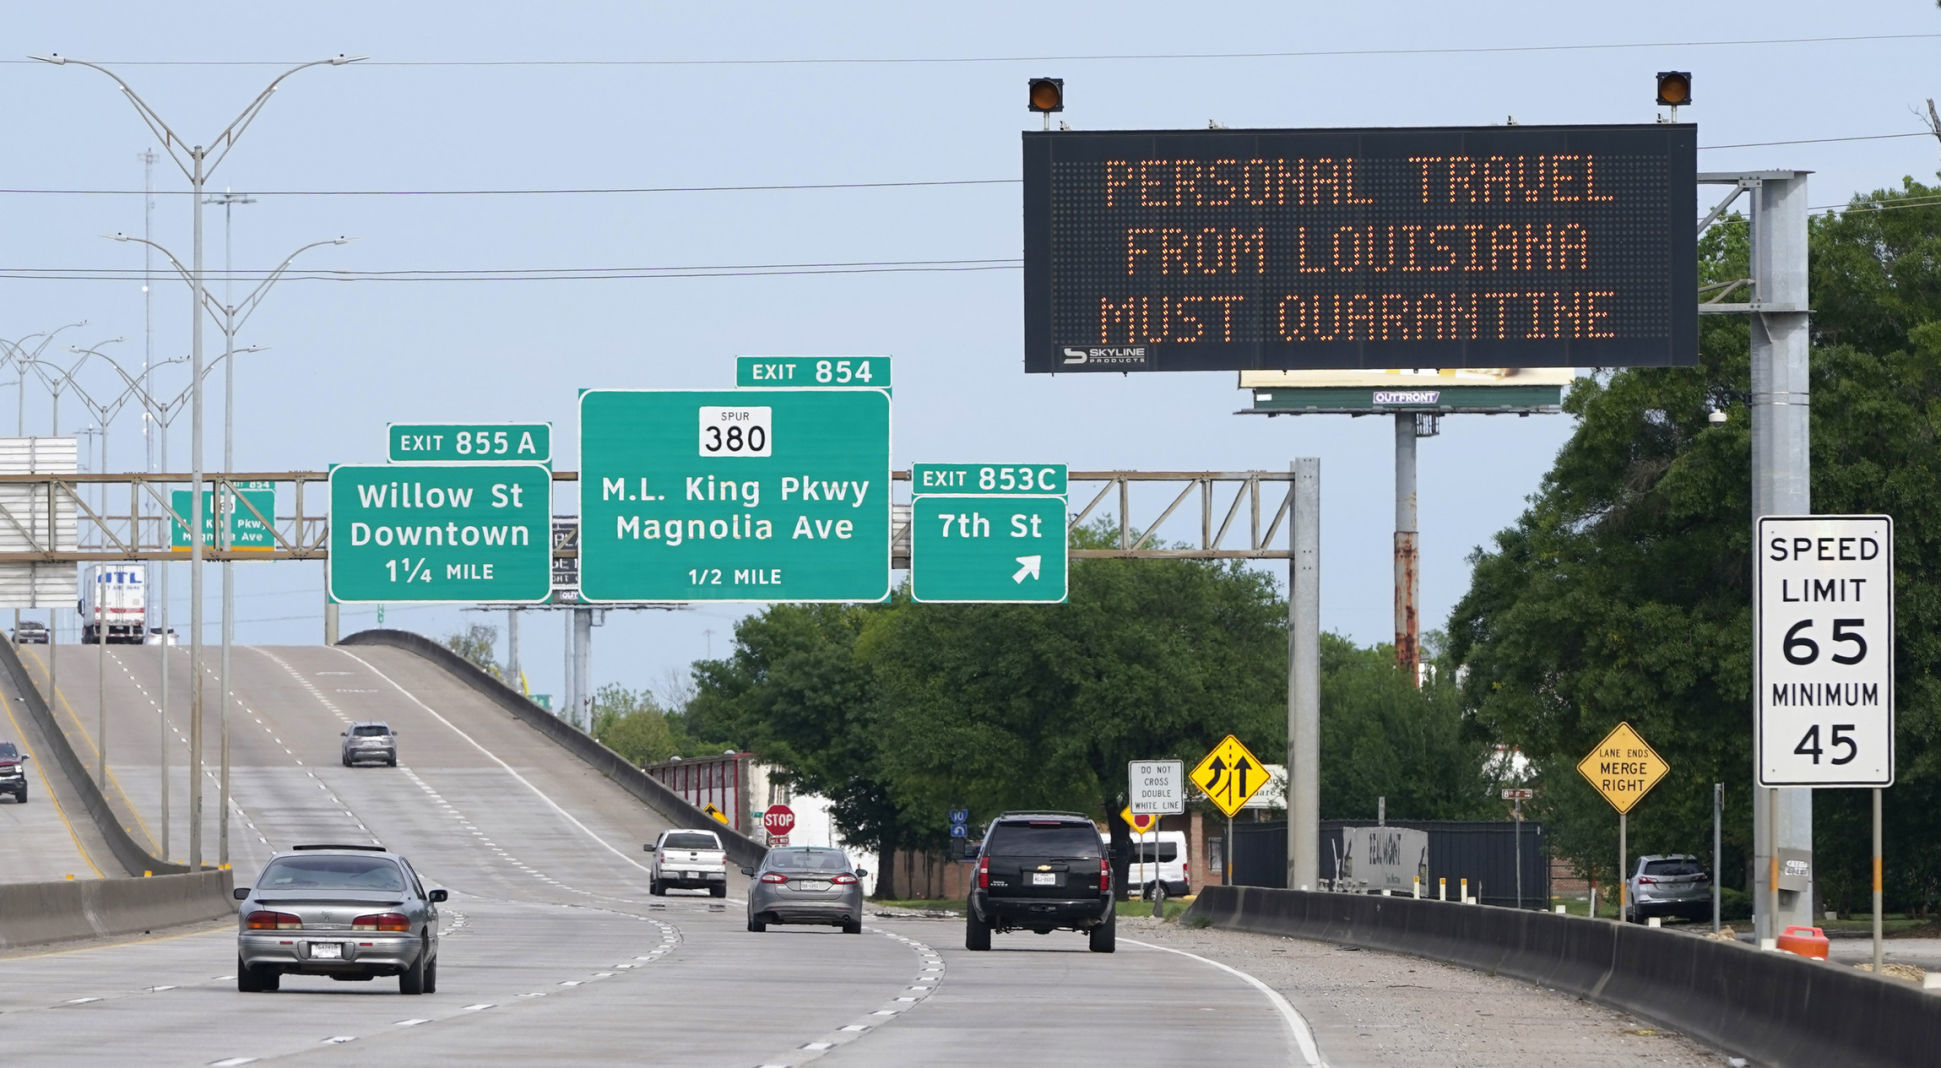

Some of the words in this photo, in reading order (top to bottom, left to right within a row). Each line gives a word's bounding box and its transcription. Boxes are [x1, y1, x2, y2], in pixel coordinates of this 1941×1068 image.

[1108, 159, 1372, 206] PERSONAL
[1409, 156, 1612, 202] TRAVEL
[1129, 228, 1264, 274] FROM
[1300, 224, 1586, 272] LOUISIANA
[1102, 296, 1243, 343] MUST
[1280, 292, 1614, 340] QUARANTINE
[1090, 348, 1144, 356] SKYLINE
[753, 364, 796, 379] EXIT
[816, 360, 872, 383] 854
[1376, 393, 1434, 402] OUTFRONT
[722, 412, 749, 421] SPUR
[402, 435, 443, 450] EXIT
[456, 432, 508, 454] 855
[518, 432, 536, 453] A
[706, 426, 765, 451] 380
[924, 471, 966, 486] EXIT
[979, 467, 1055, 490] 853C
[358, 482, 473, 508] Willow
[492, 484, 522, 507] St
[603, 478, 664, 500] M.L.
[687, 475, 759, 507] King
[782, 476, 869, 507] Pkwy
[352, 522, 528, 546] Downtown
[617, 515, 772, 546] Magnolia
[792, 516, 853, 539] Ave
[939, 512, 989, 537] 7th
[1011, 514, 1041, 537] St
[241, 533, 263, 541] Ave
[1771, 538, 1878, 561] SPEED
[447, 564, 493, 579] MILE
[689, 569, 721, 584] 1/2
[735, 569, 781, 584] MILE
[1783, 579, 1866, 602] LIMIT
[1783, 619, 1867, 665] 65
[1773, 683, 1877, 706] MINIMUM
[1600, 749, 1620, 757] LANE
[1794, 725, 1857, 765] 45
[1601, 762, 1647, 774] MERGE
[1603, 780, 1644, 791] RIGHT
[954, 812, 963, 820] 10
[1163, 801, 1178, 809] LINE
[765, 814, 793, 827] STOP
